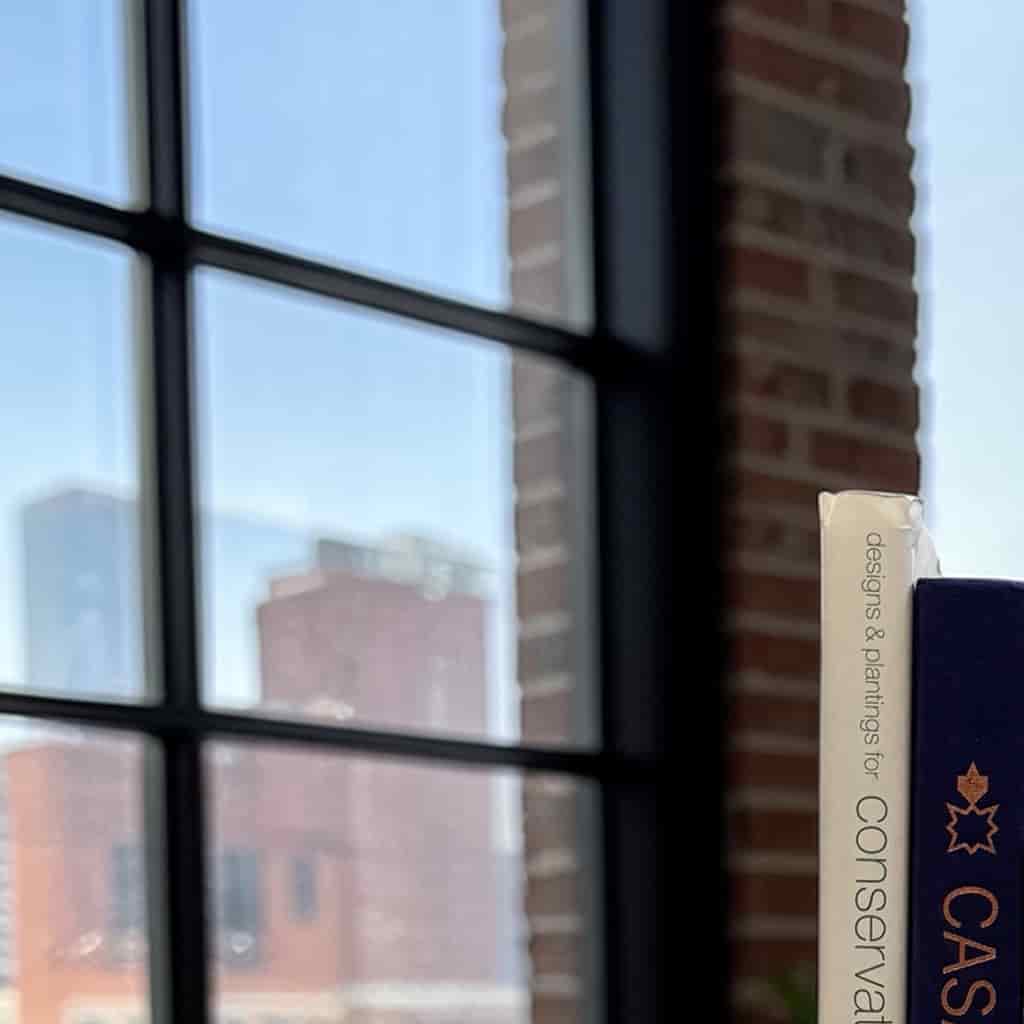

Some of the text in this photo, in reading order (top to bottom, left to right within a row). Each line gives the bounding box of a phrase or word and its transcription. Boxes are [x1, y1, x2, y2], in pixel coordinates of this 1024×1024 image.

[860, 531, 886, 621] designs
[864, 626, 886, 642] &
[859, 648, 885, 746] plantings
[863, 752, 885, 780] for
